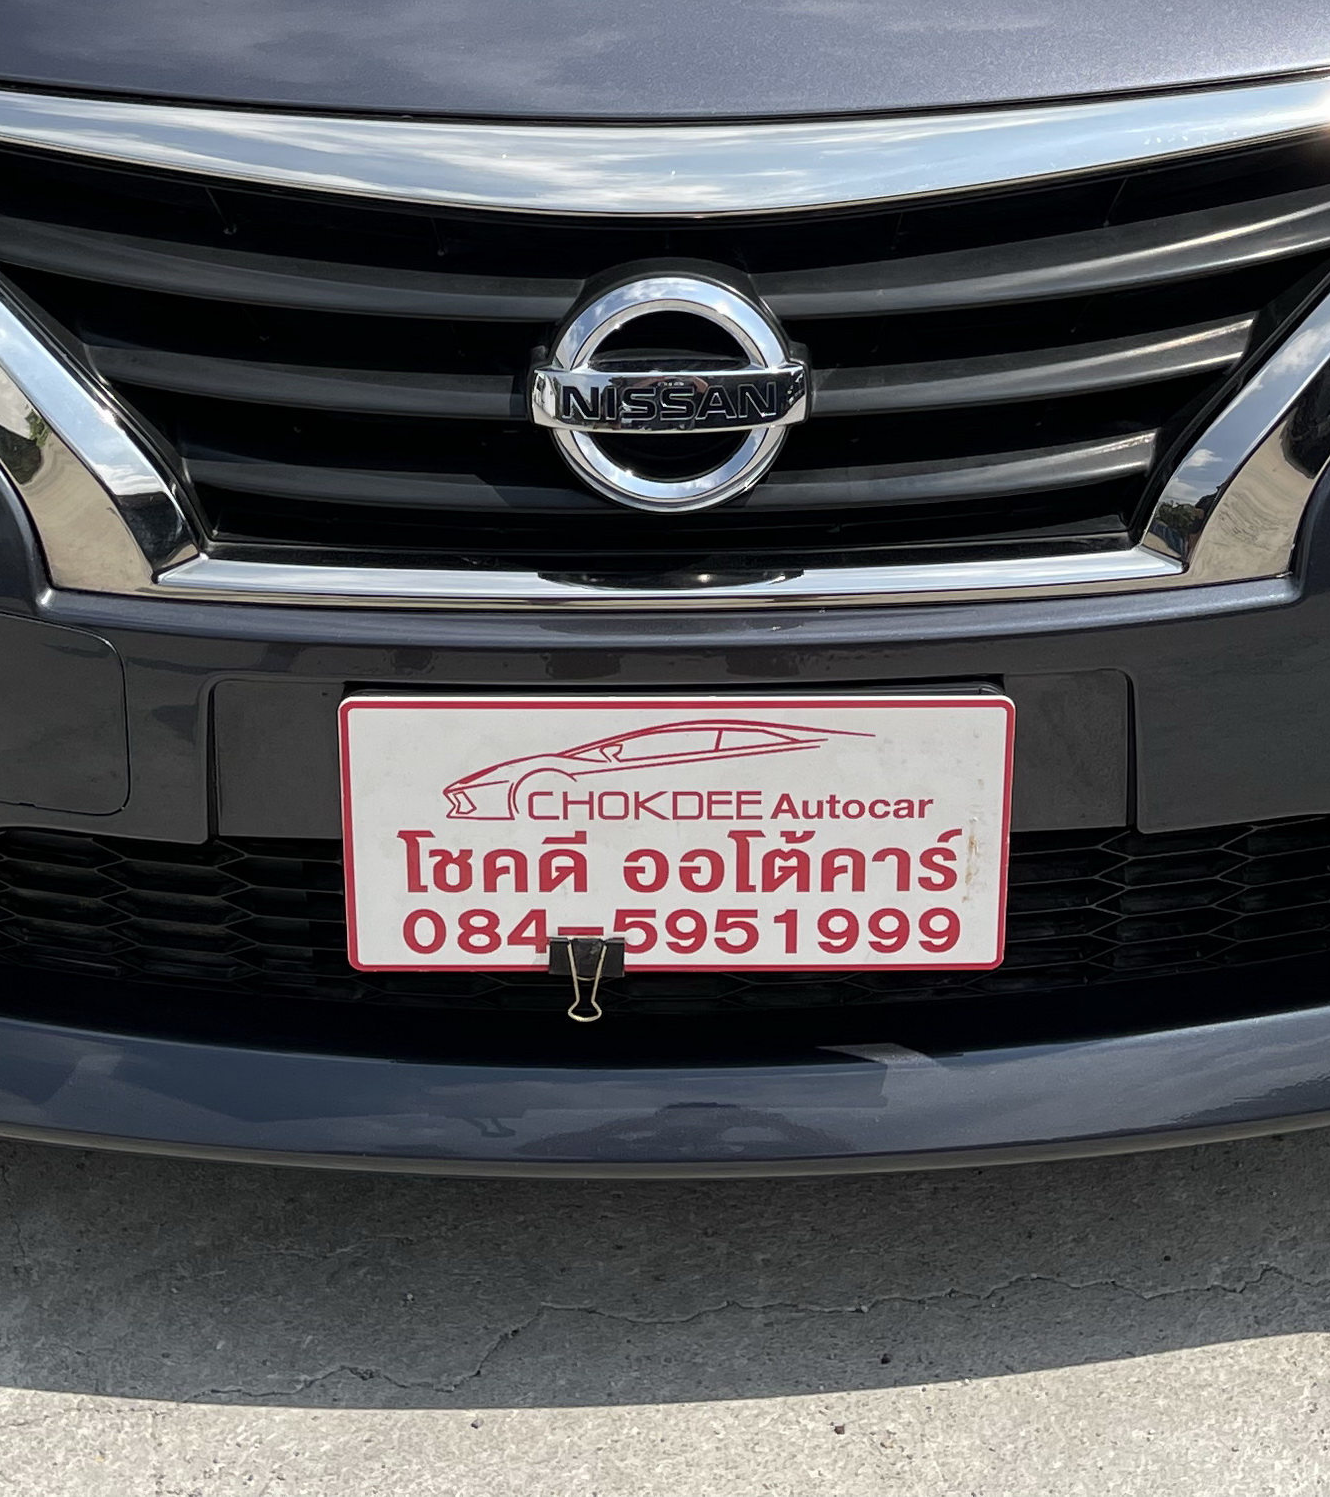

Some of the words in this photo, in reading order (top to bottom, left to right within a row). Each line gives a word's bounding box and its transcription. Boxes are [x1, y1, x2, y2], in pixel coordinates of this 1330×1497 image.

[562, 382, 777, 422] NISSAN
[527, 790, 763, 821] CHOKDEE
[770, 792, 934, 820] Autocar
[397, 830, 589, 893] โชคดี
[623, 829, 962, 893] ออโต้คาร์
[402, 907, 962, 955] 084-5951999
